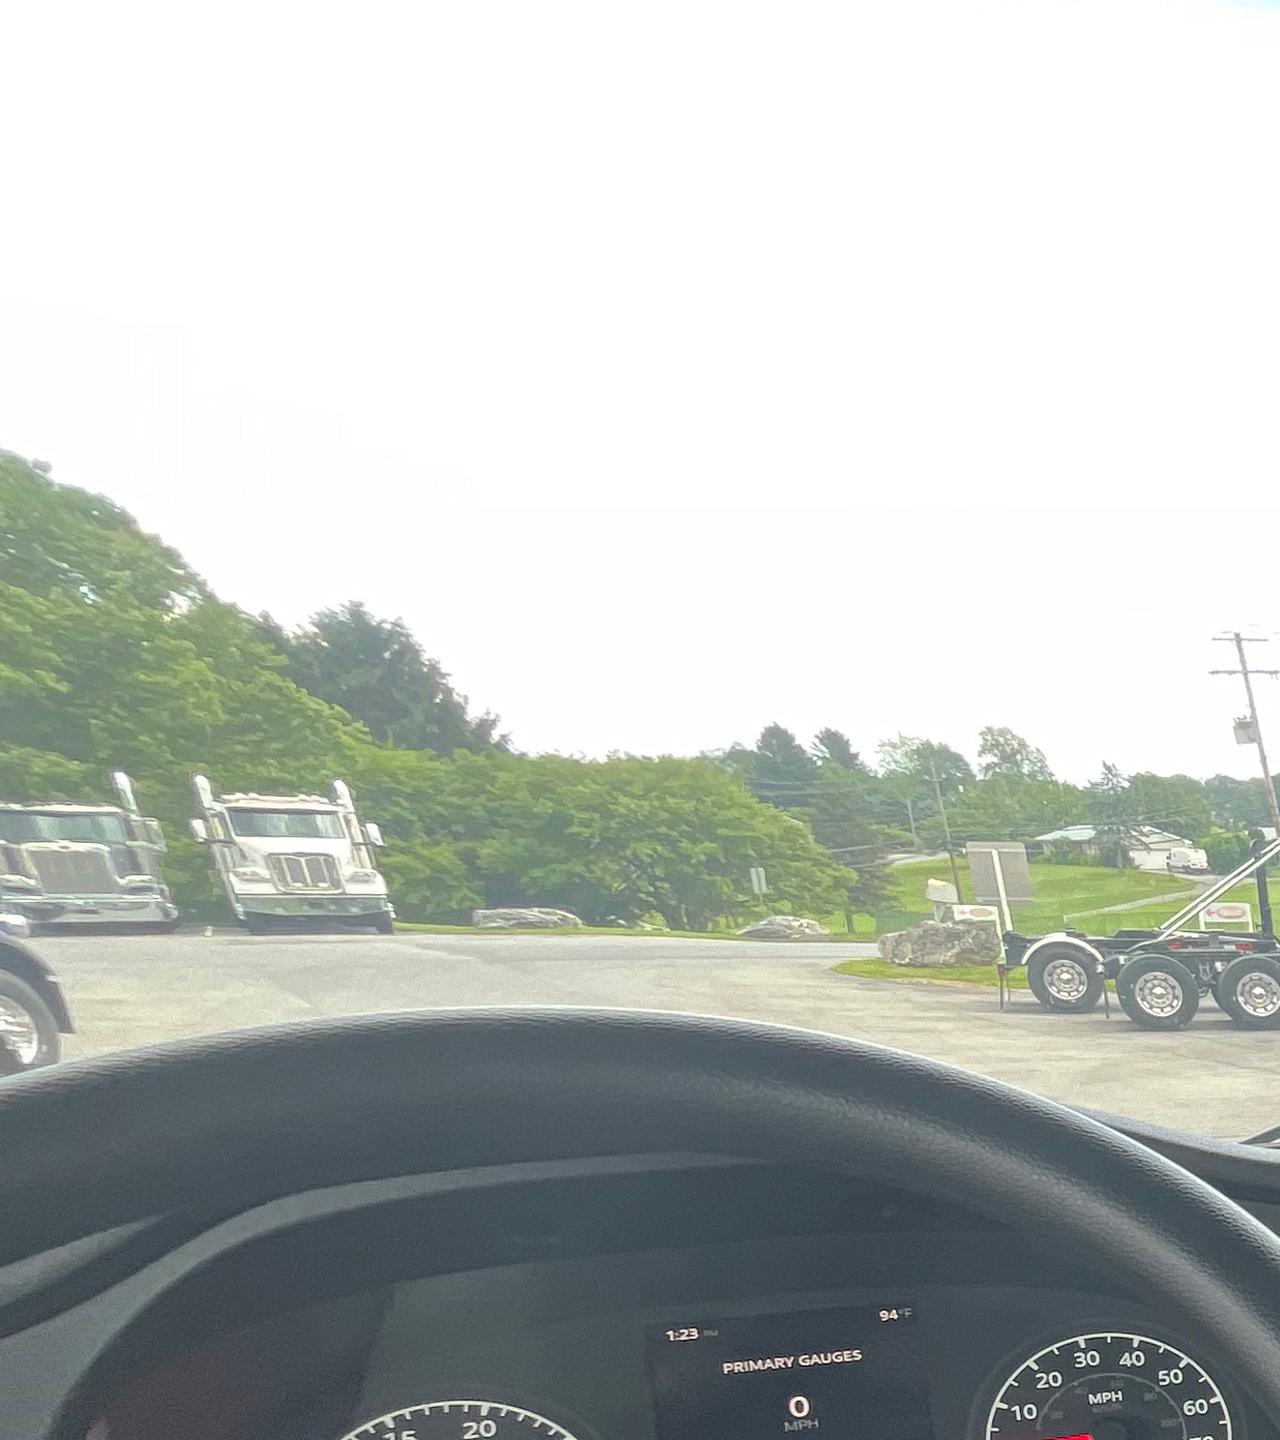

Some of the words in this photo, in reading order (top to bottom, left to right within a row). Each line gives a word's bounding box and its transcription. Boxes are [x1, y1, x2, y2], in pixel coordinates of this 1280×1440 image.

[665, 1327, 699, 1342] 1:23
[722, 1356, 794, 1375] PRIMARY
[799, 1349, 863, 1367] GAUGES
[1074, 1350, 1100, 1368] 30
[1119, 1351, 1145, 1367] 40
[1035, 1371, 1062, 1389] 20
[1158, 1369, 1183, 1386] 50
[1088, 1391, 1123, 1405] MPH
[788, 1396, 810, 1418] 0
[1010, 1404, 1037, 1421] 10
[1183, 1399, 1208, 1415] 60
[463, 1420, 497, 1440] 20
[784, 1418, 819, 1433] MPH
